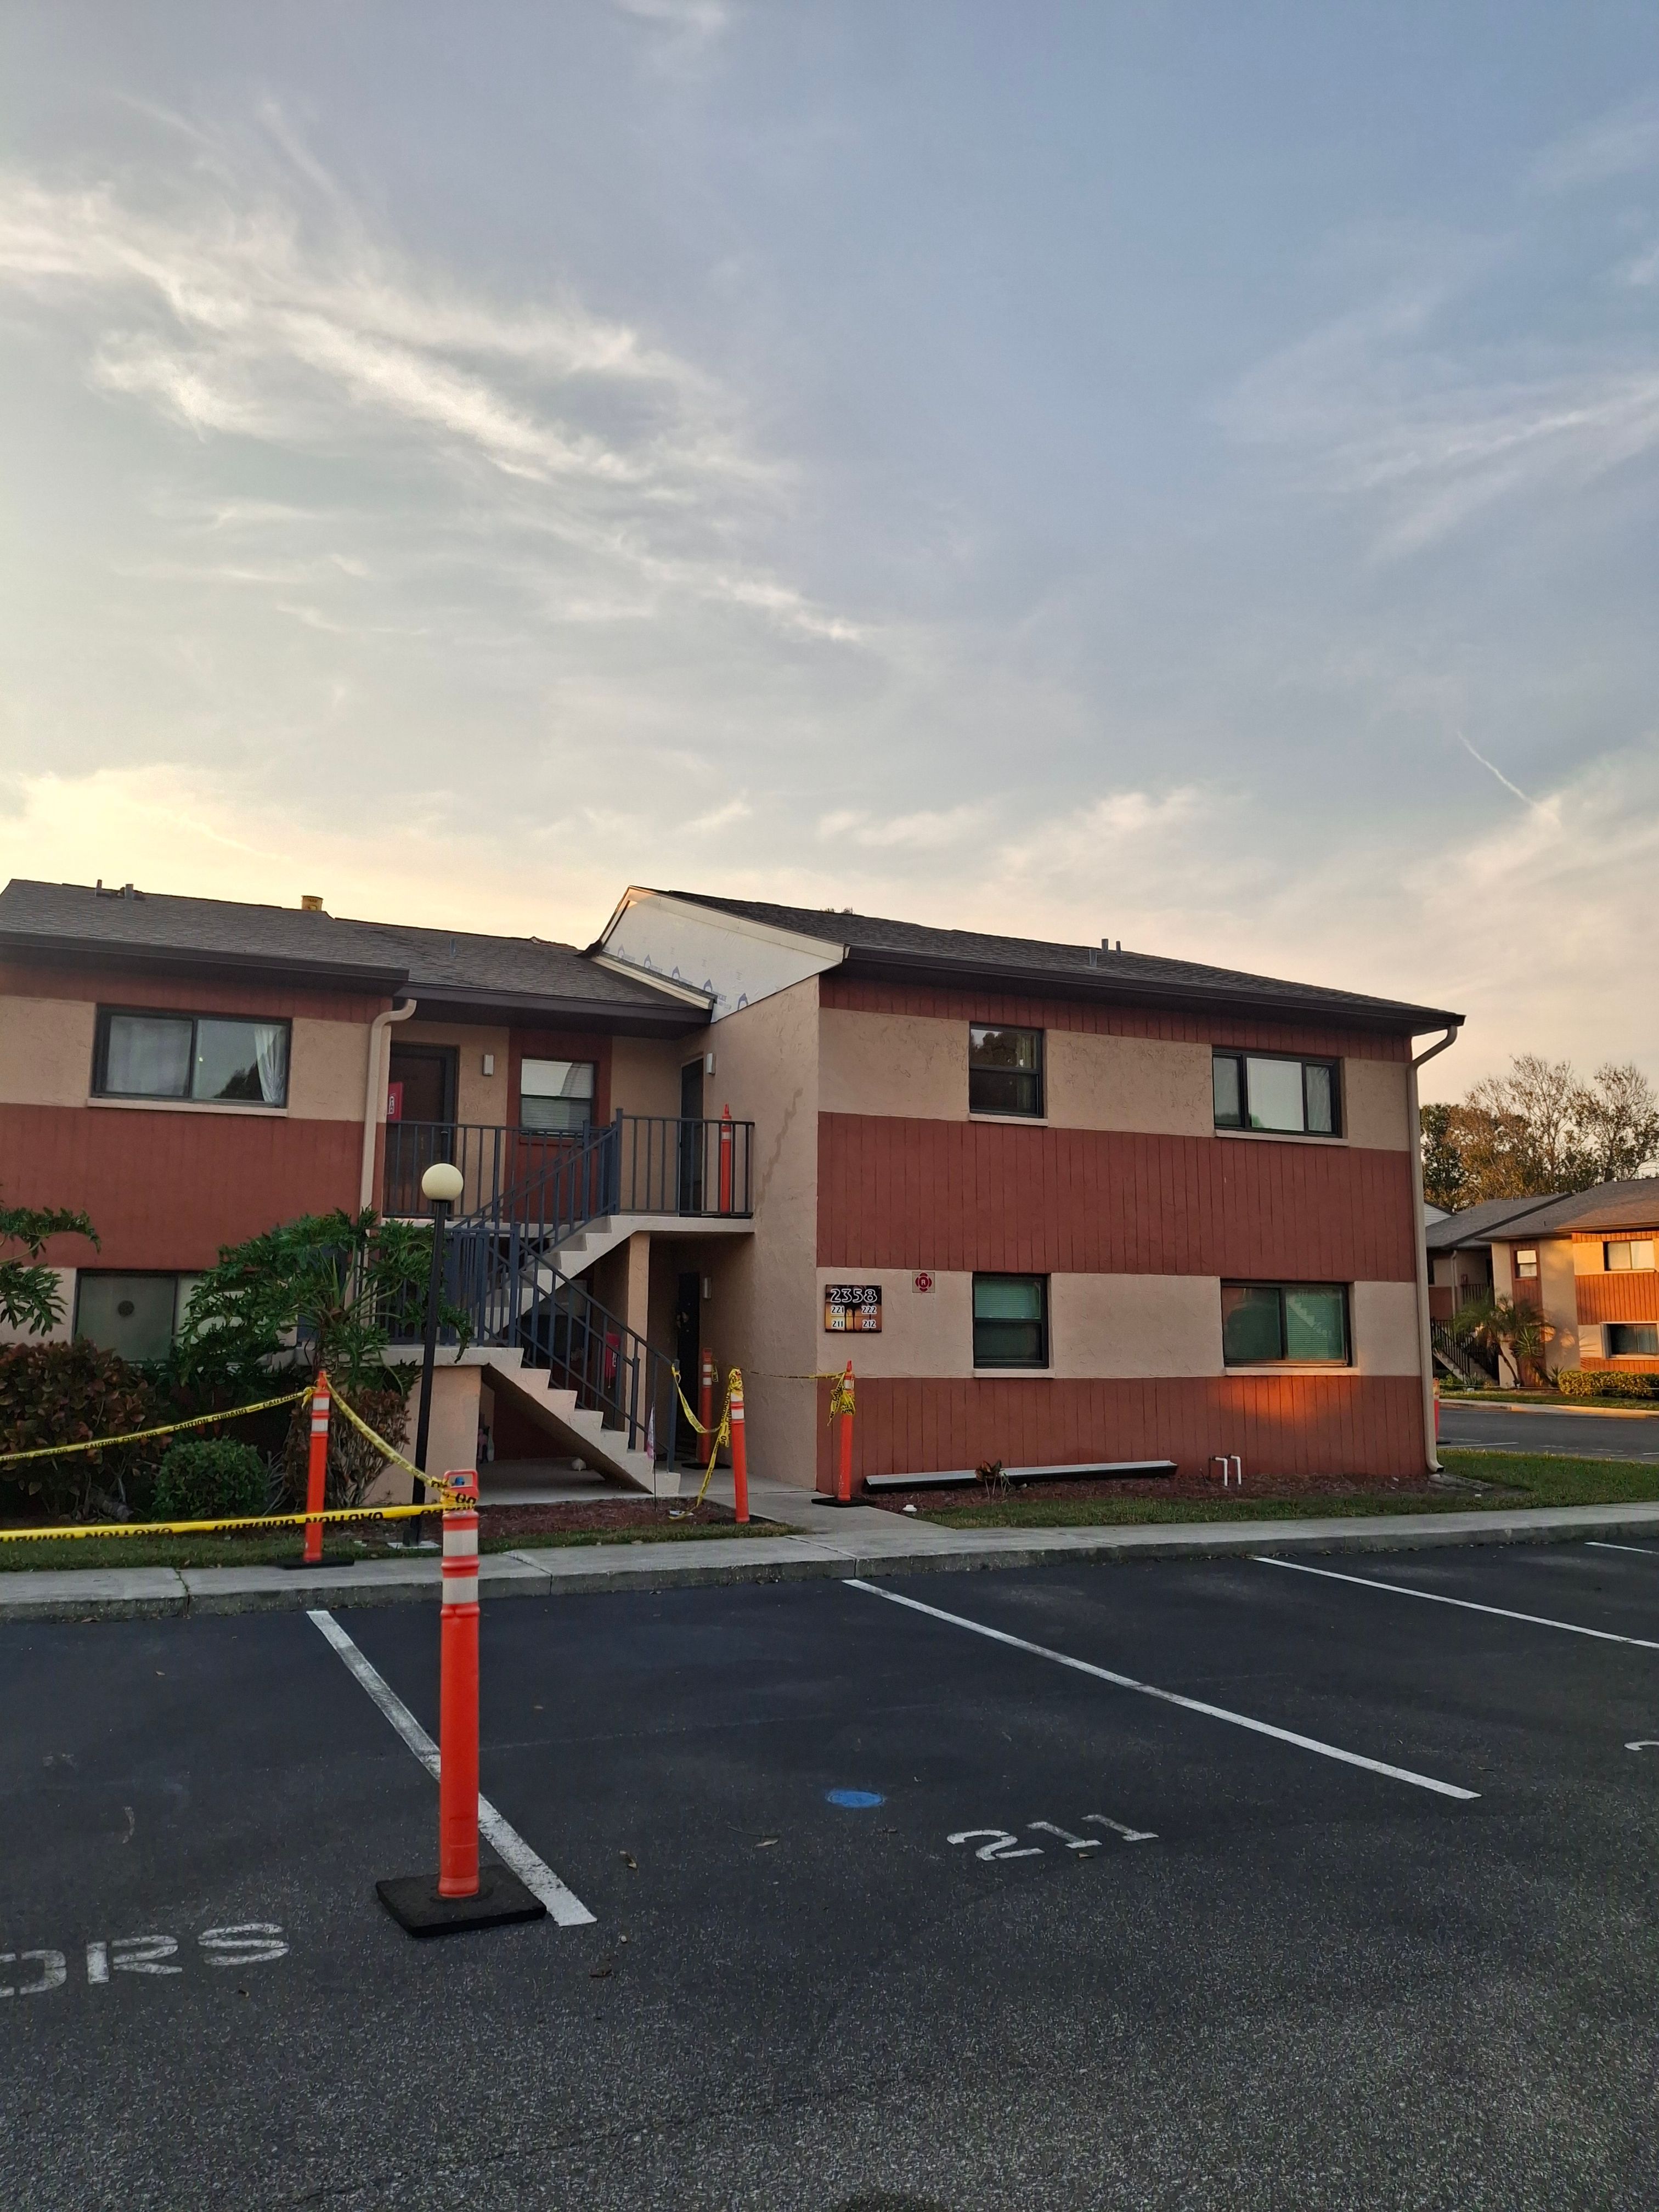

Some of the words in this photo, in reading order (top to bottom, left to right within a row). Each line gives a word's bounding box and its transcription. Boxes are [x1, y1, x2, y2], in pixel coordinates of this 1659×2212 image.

[830, 1288, 877, 1303] 2358
[831, 1306, 844, 1314] 221
[862, 1306, 877, 1314] 222
[173, 1418, 208, 1431] CAUTION
[212, 1408, 247, 1421] CUIDADO
[946, 1814, 1159, 1861] 211
